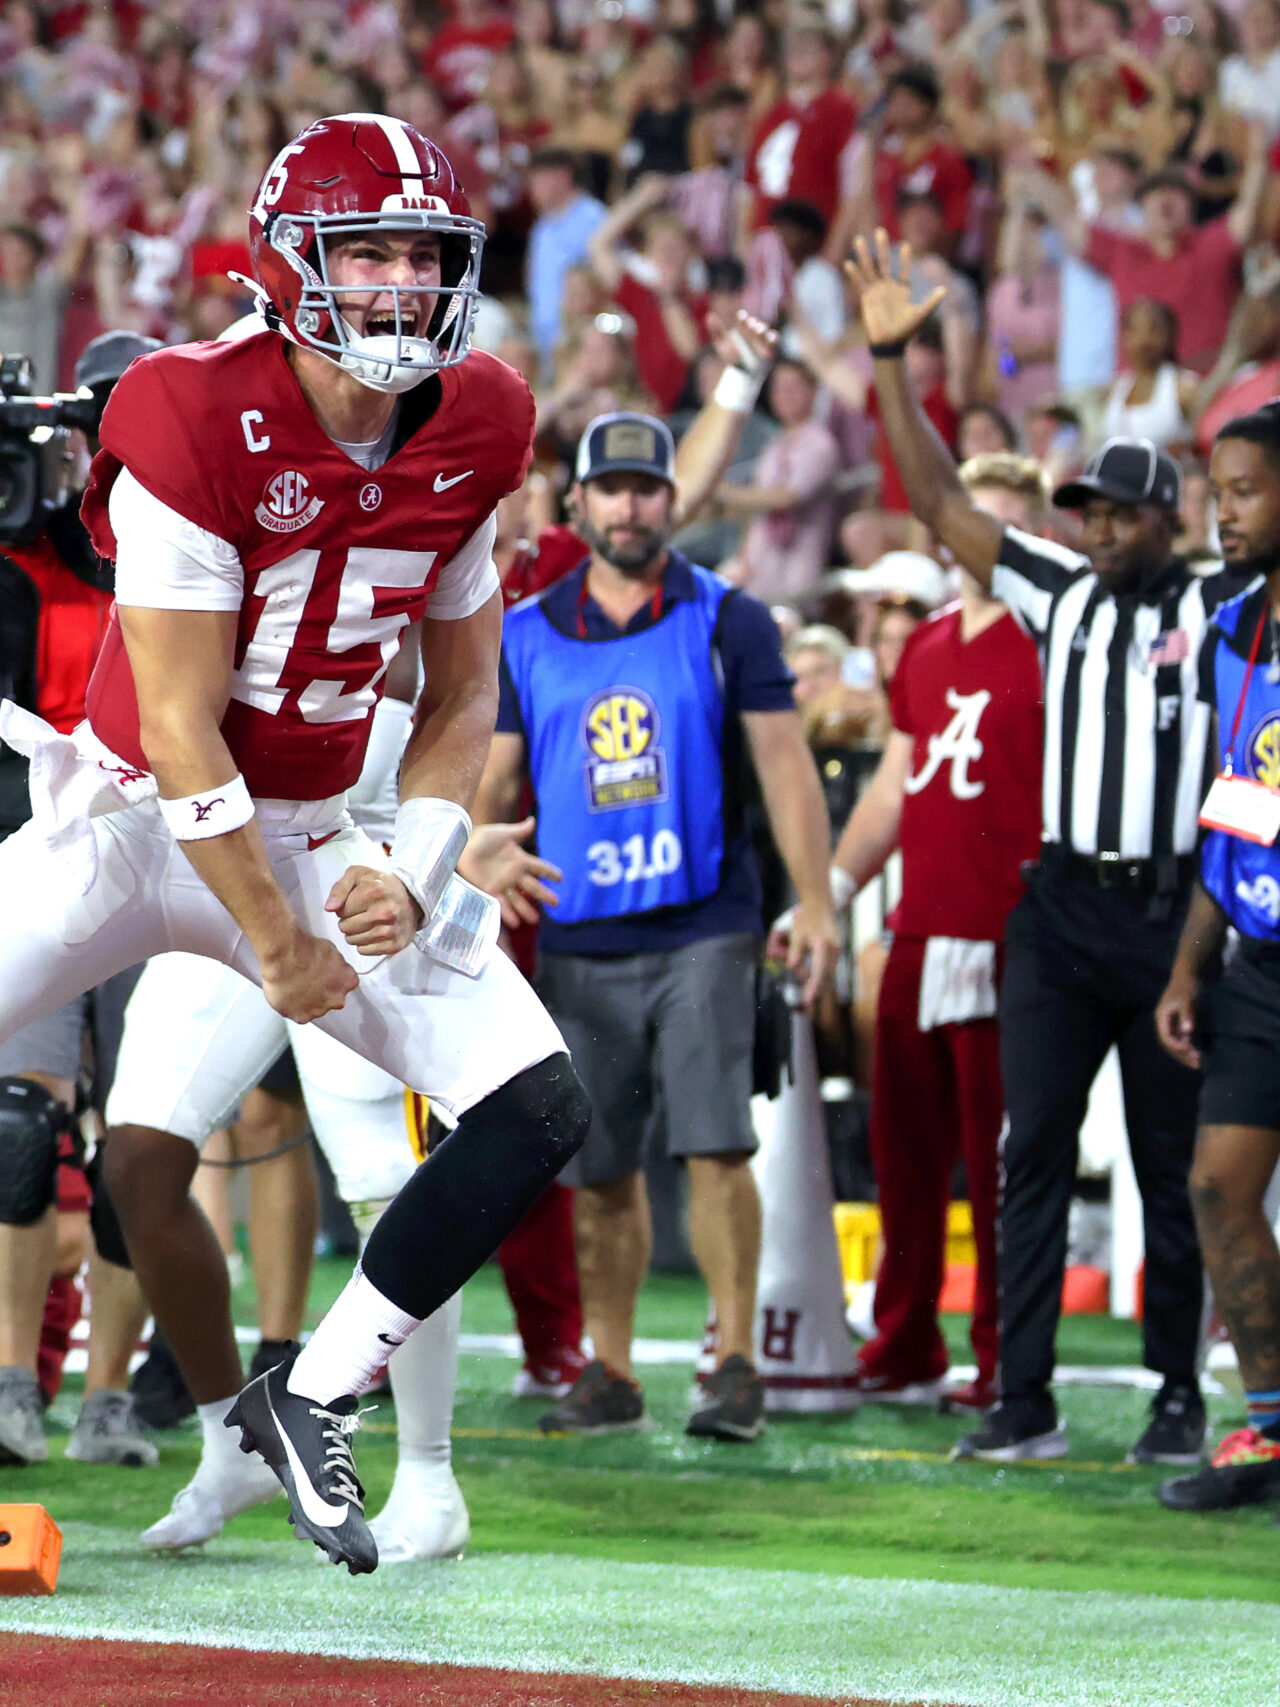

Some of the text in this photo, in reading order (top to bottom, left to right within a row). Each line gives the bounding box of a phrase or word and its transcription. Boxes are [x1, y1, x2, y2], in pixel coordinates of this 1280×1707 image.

[401, 197, 437, 210] BAMA
[240, 409, 271, 453] C
[268, 470, 310, 516] SEC
[260, 510, 314, 531] GRADUATE
[231, 546, 438, 724] 15
[588, 694, 650, 762] SEC
[1157, 695, 1180, 731] F
[904, 686, 992, 800] A
[586, 828, 683, 888] 310
